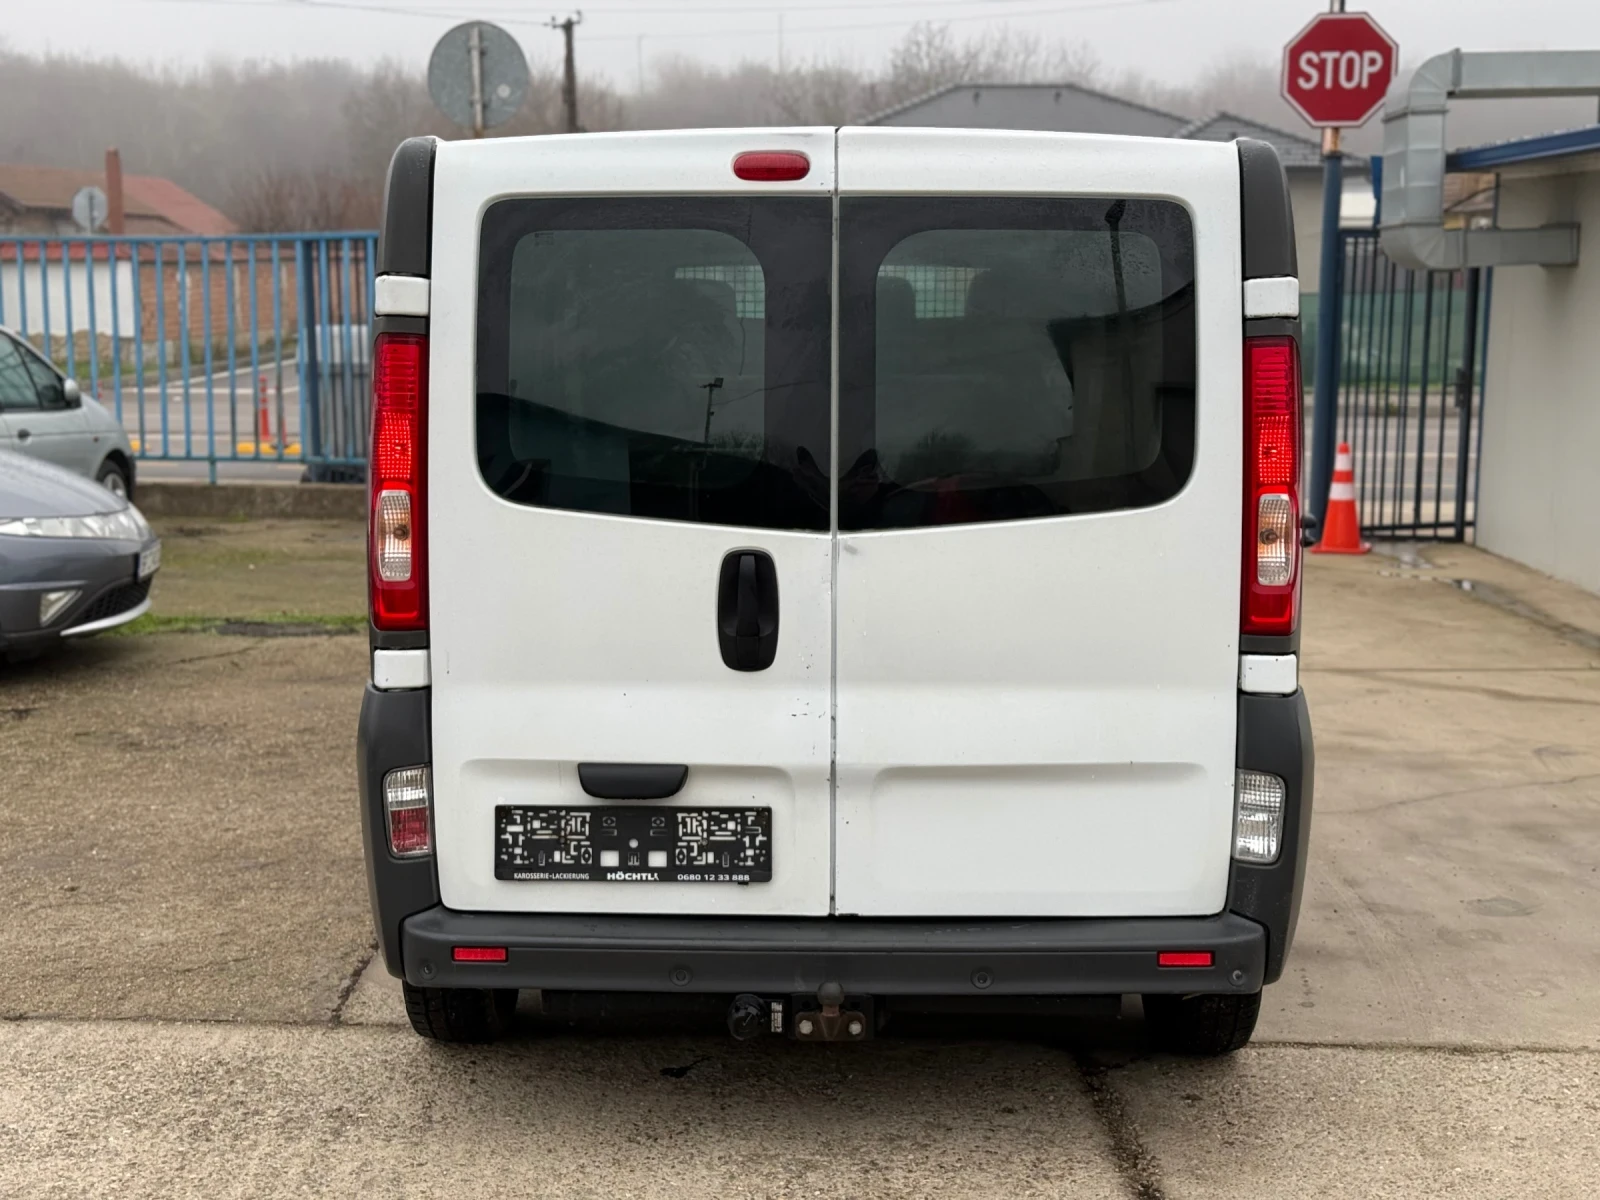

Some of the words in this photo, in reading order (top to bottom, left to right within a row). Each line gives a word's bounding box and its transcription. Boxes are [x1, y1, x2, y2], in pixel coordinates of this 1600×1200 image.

[1297, 50, 1384, 90] STOP
[513, 872, 590, 880] KAROSSERIE-LACKIERUNG
[677, 873, 701, 881] 0680
[704, 873, 716, 881] 12
[717, 873, 730, 881] 33
